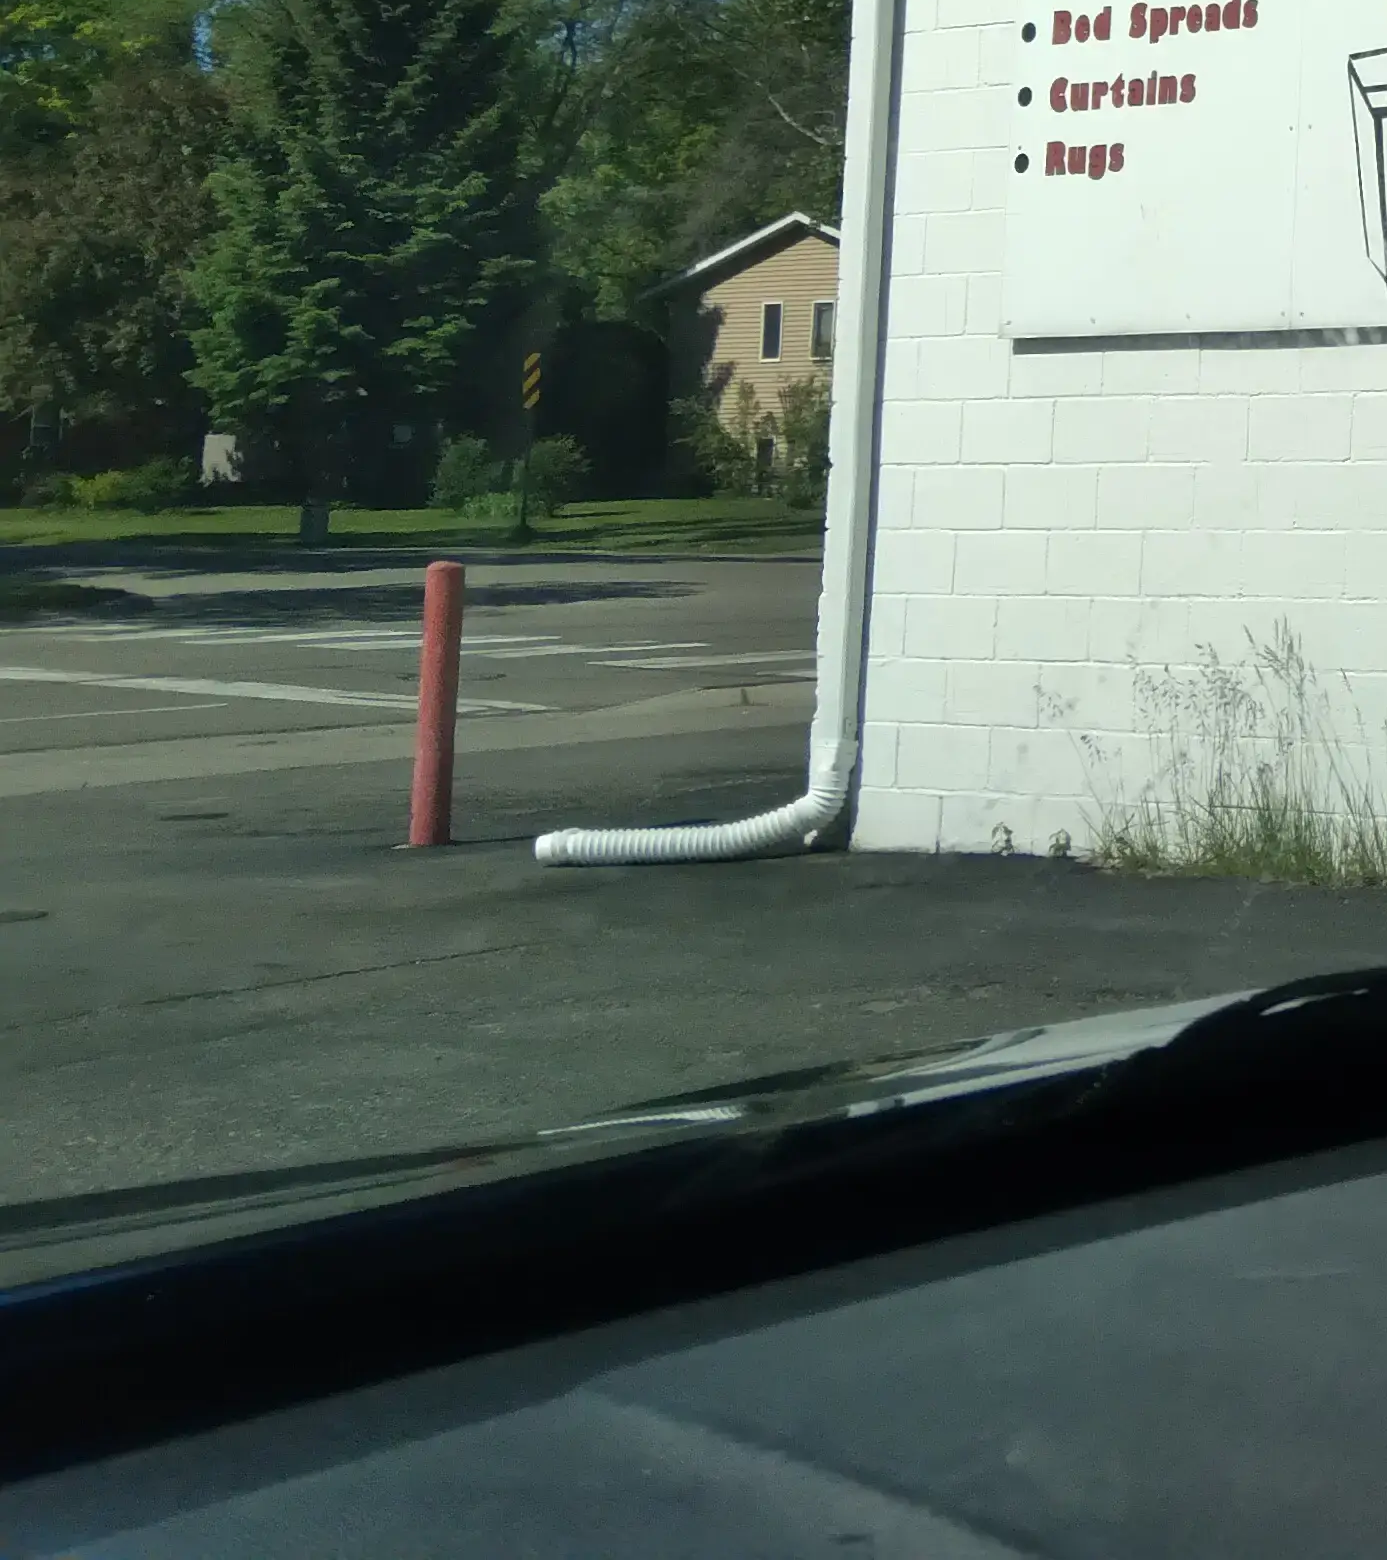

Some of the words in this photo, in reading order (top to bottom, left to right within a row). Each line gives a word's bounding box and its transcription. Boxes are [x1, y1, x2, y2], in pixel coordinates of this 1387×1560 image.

[1052, 5, 1112, 45] Bed
[1048, 69, 1197, 113] Curtains
[1044, 140, 1126, 180] Rugs
